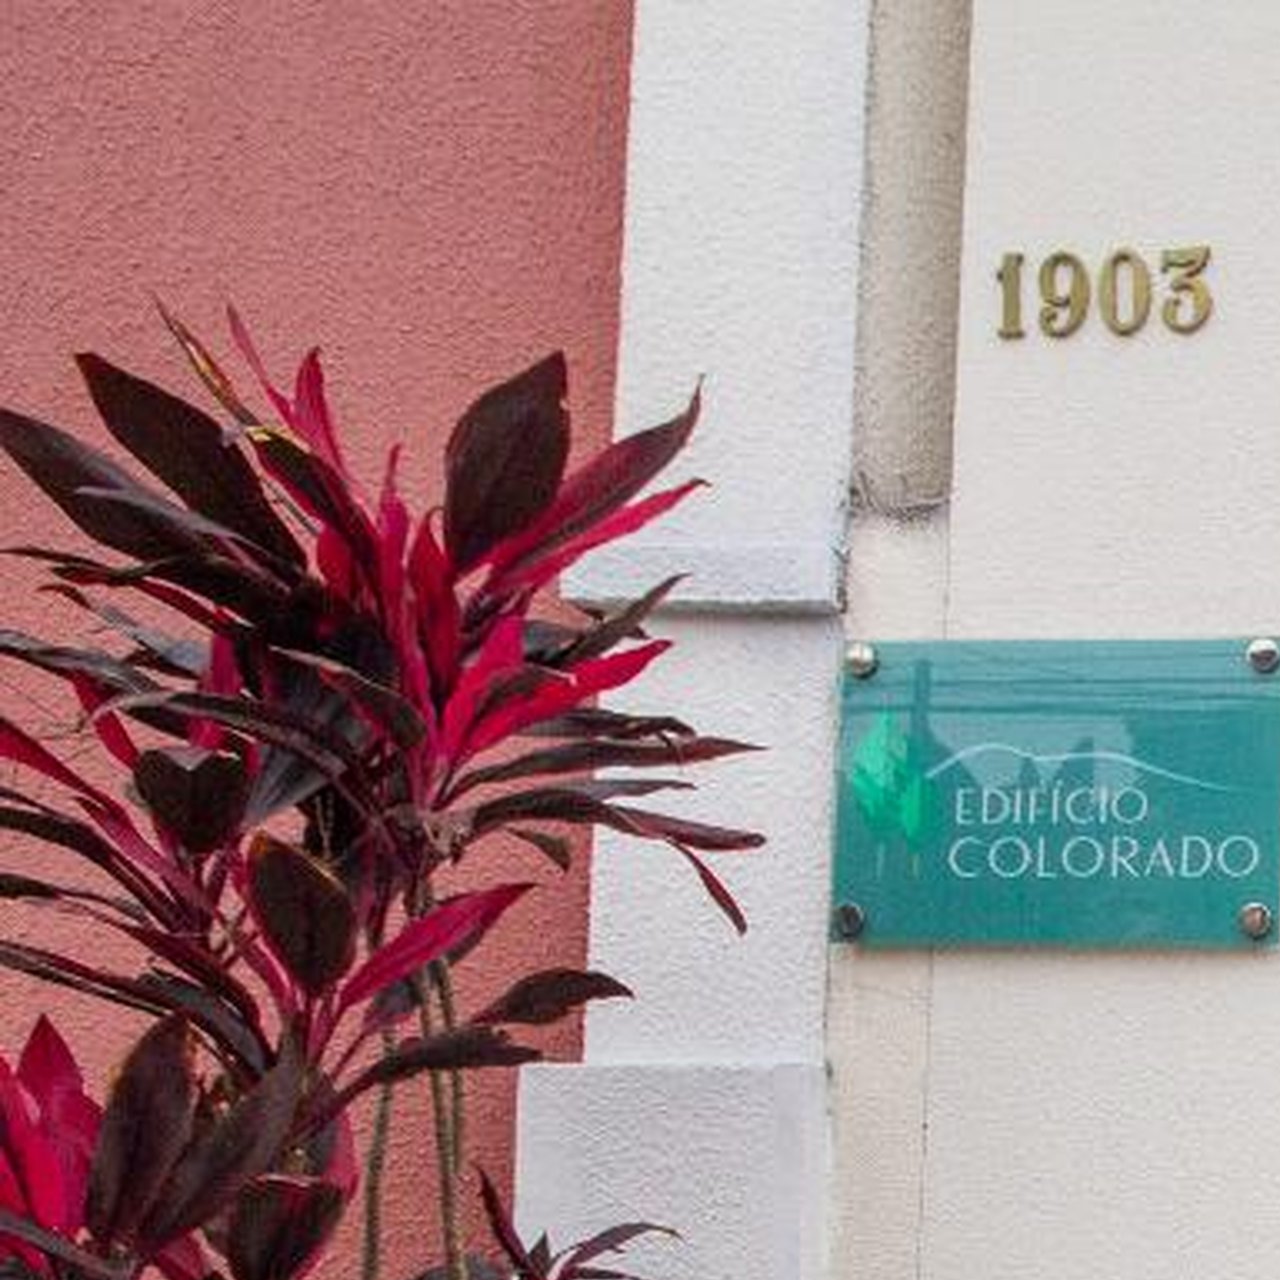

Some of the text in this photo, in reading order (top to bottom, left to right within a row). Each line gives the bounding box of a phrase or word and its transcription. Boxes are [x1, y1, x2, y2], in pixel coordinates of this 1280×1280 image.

[997, 246, 1213, 339] 1903
[954, 780, 1148, 825] EDIFÍCIO
[948, 836, 1260, 879] COLORADO
